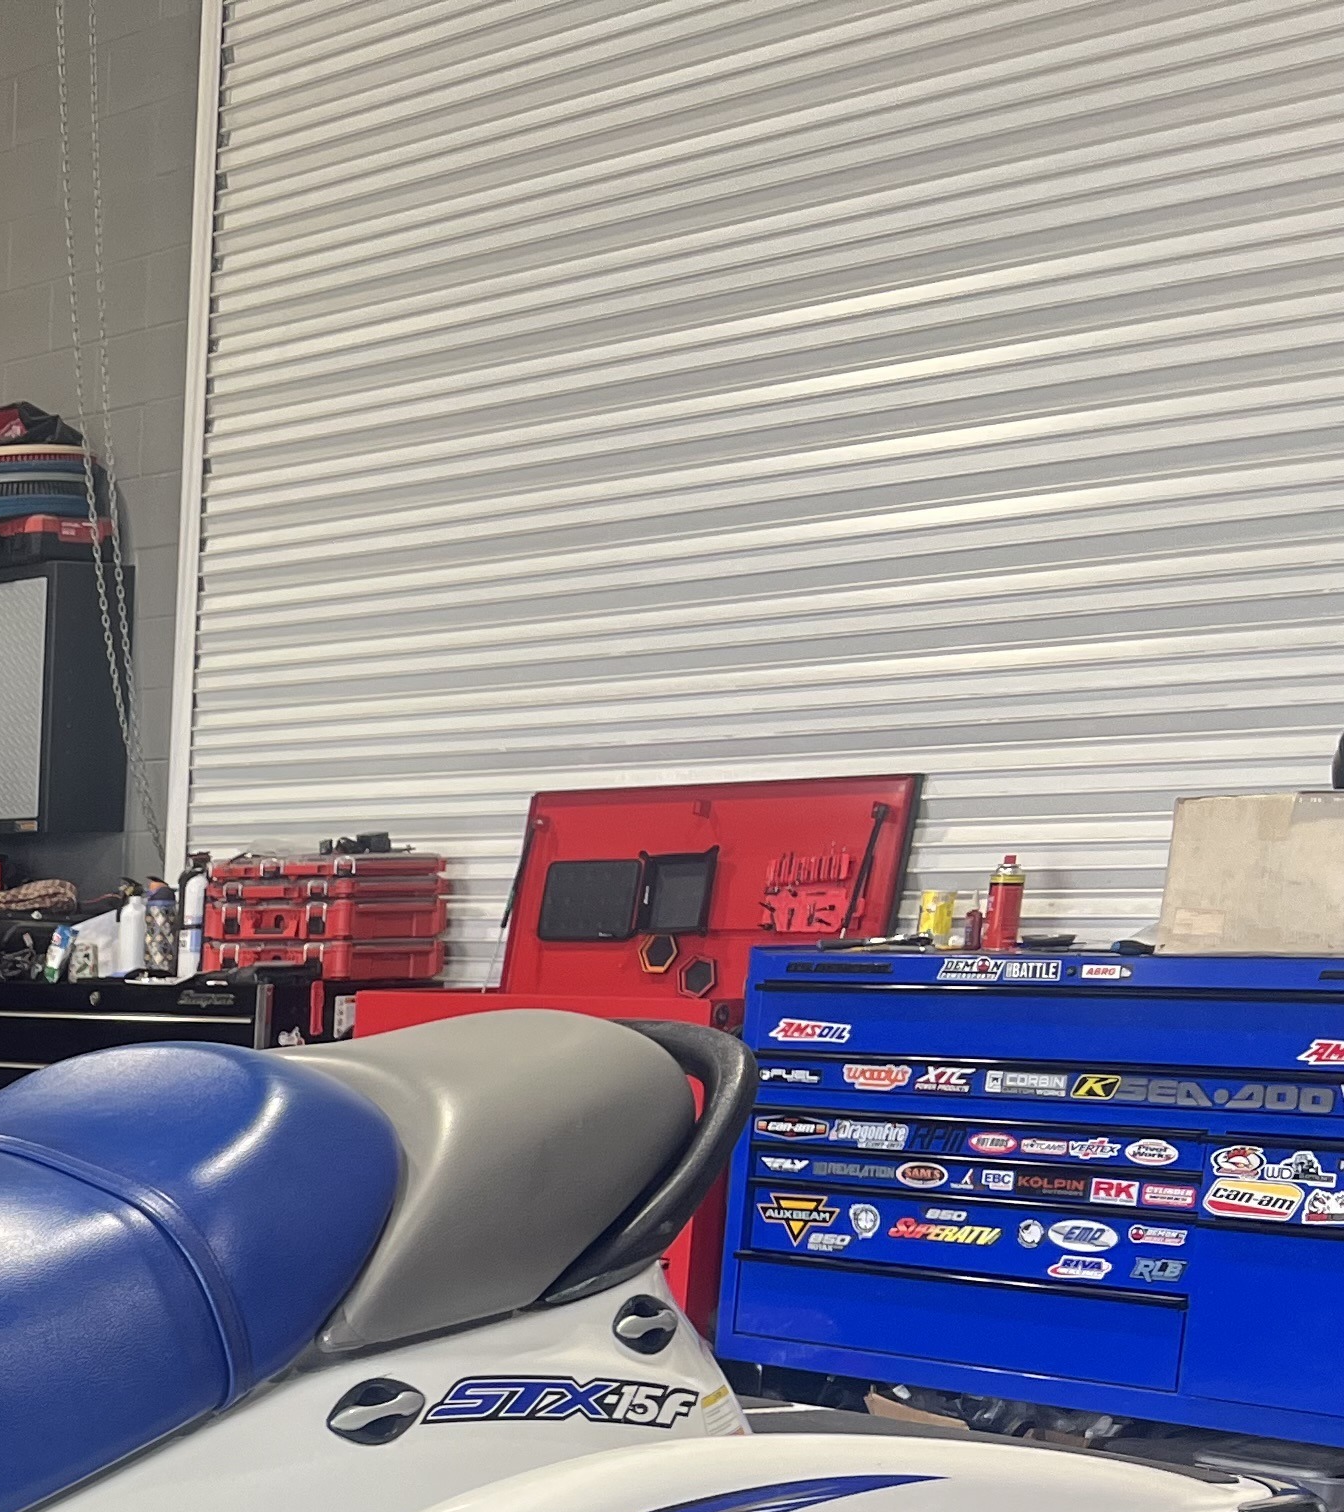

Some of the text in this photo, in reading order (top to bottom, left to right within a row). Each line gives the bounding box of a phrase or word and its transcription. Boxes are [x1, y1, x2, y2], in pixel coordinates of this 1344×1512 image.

[1012, 962, 1058, 979] BATTLE
[1086, 967, 1116, 976] ABRO
[774, 1021, 848, 1040] AMSOIL
[916, 1066, 976, 1084] XTC
[1005, 1074, 1064, 1088] CORBIN
[1070, 1143, 1120, 1154] VERTEX
[984, 1173, 1012, 1185] EBC
[1018, 1176, 1085, 1191] KOLPIN
[1093, 1181, 1137, 1199] RK
[1212, 1188, 1296, 1210] can-am
[765, 1209, 830, 1221] AUXBEAM
[1064, 1226, 1107, 1242] EMP
[1062, 1259, 1103, 1270] RIVA
